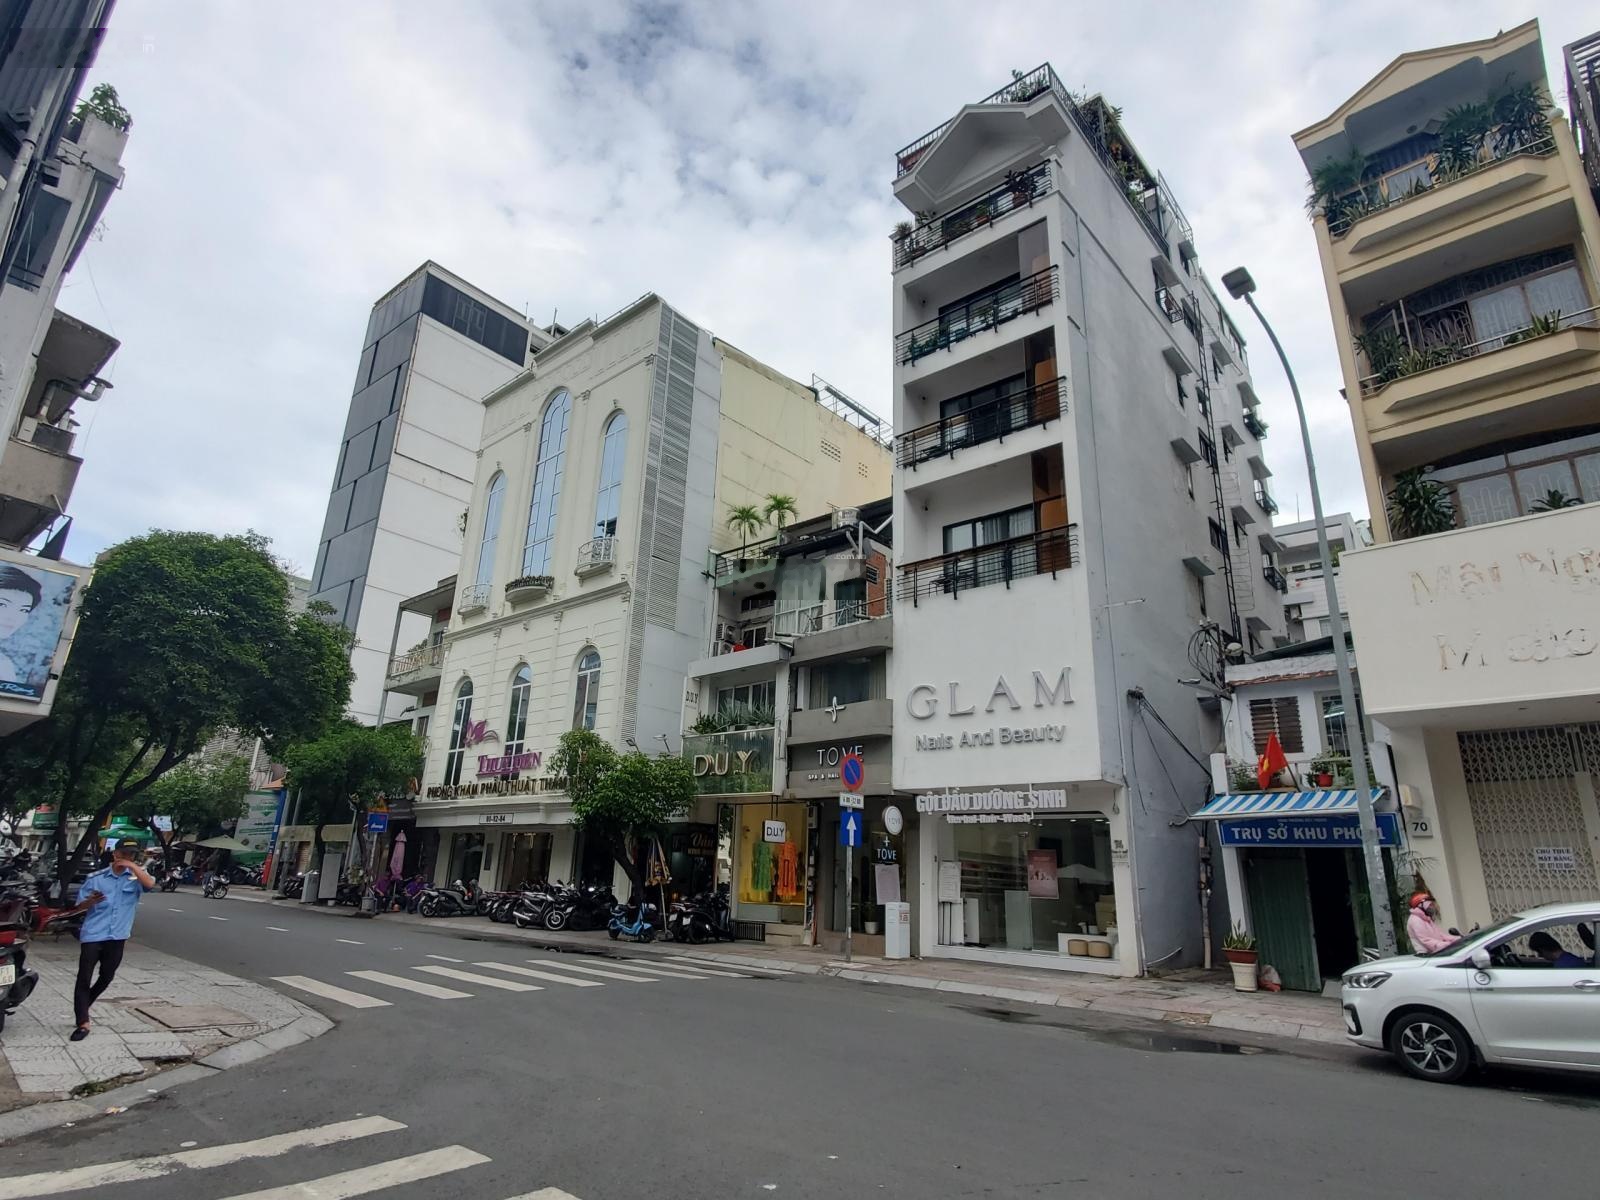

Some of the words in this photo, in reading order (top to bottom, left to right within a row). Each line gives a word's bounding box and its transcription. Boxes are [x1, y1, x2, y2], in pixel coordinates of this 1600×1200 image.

[905, 666, 1076, 720] GLAM
[915, 732, 954, 752] Nails
[959, 728, 994, 748] And
[998, 723, 1068, 747] Beauty
[816, 745, 864, 767] TOVE
[1027, 789, 1067, 808] SINH
[1231, 826, 1261, 842] TRỤ
[1268, 823, 1287, 840] SỞ
[1293, 827, 1327, 840] KHU
[1411, 821, 1428, 832] 70
[877, 848, 897, 860] TOVE
